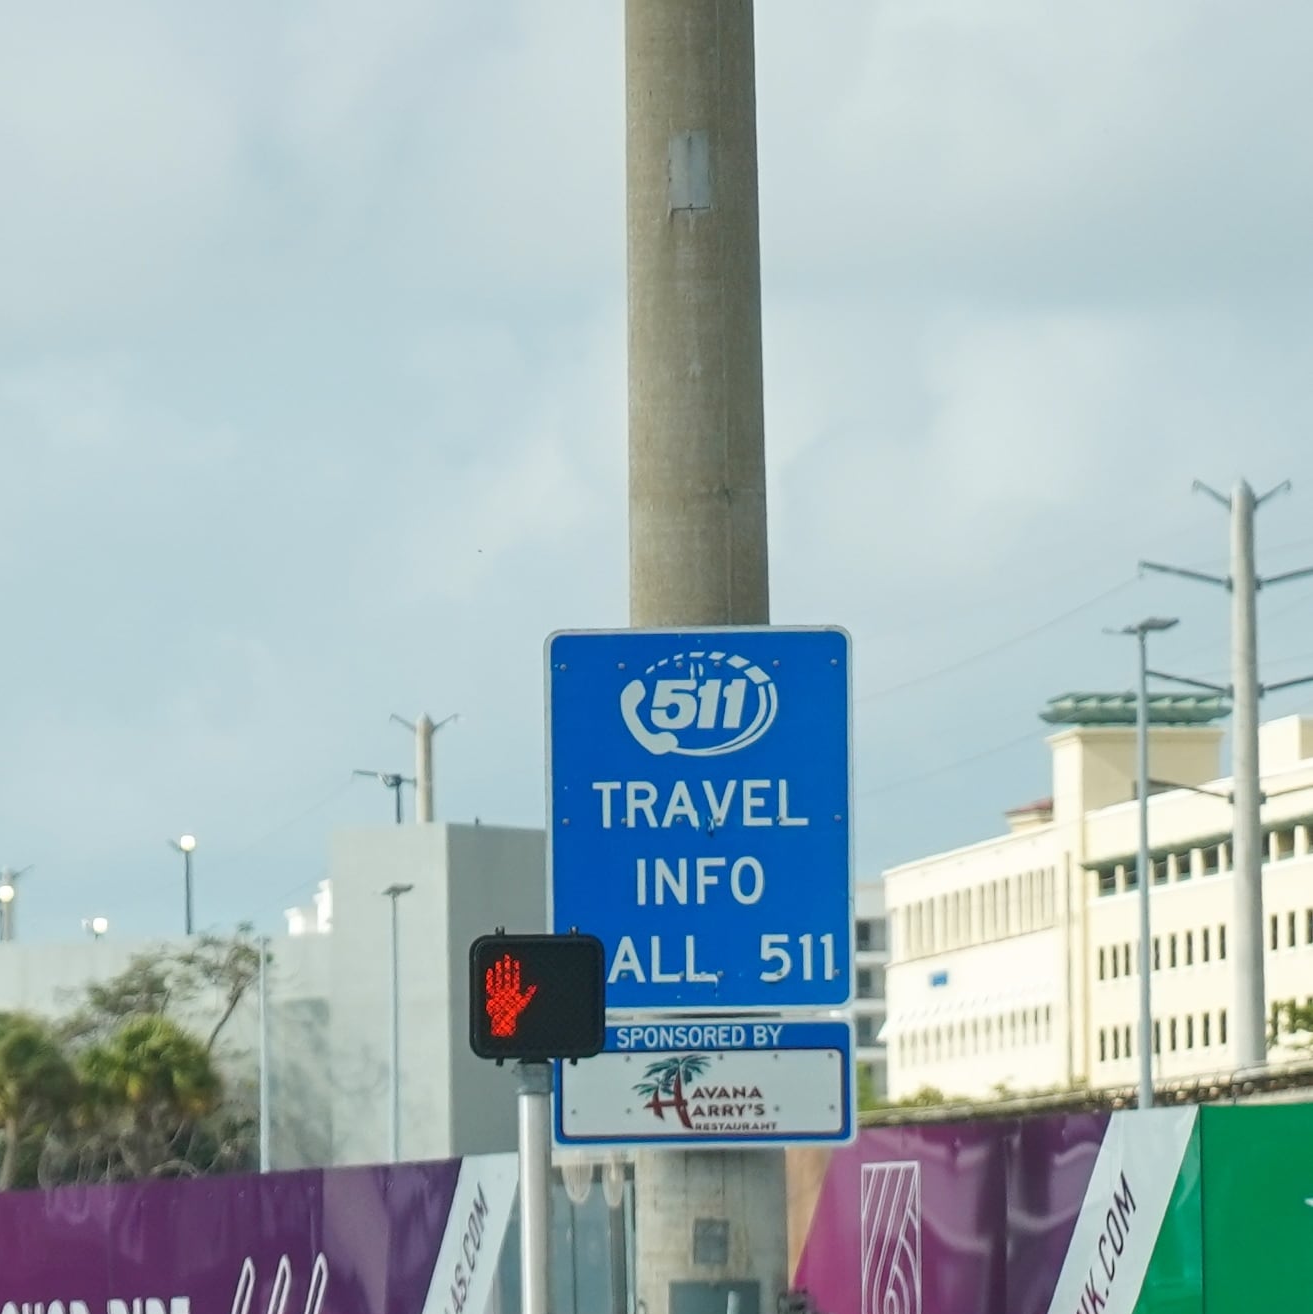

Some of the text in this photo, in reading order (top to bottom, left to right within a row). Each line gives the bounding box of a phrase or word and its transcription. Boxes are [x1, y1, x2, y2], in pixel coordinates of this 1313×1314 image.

[651, 677, 748, 730] 511
[591, 778, 810, 829] TRAVEL
[635, 855, 766, 906] INFO
[607, 933, 836, 984] ALL 511
[616, 1024, 784, 1049] SPONSORED BY
